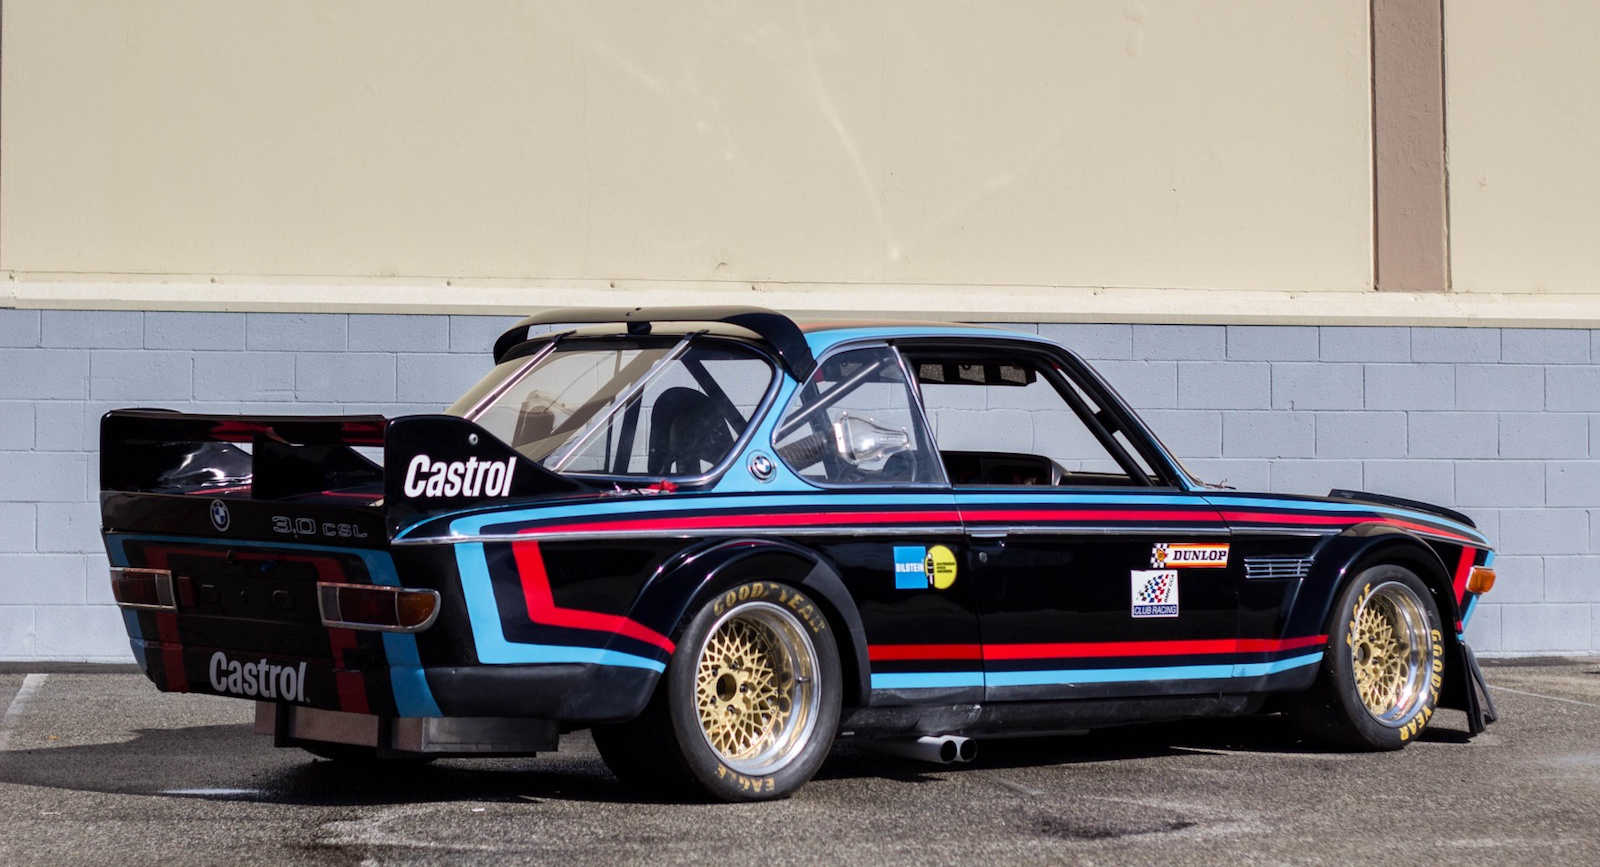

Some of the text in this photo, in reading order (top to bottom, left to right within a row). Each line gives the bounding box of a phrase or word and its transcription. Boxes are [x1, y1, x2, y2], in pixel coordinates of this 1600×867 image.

[404, 454, 518, 498] Castrol
[1173, 550, 1227, 562] DUNLOP
[1134, 605, 1176, 615] CLUB RACING
[209, 651, 309, 702] Castrol
